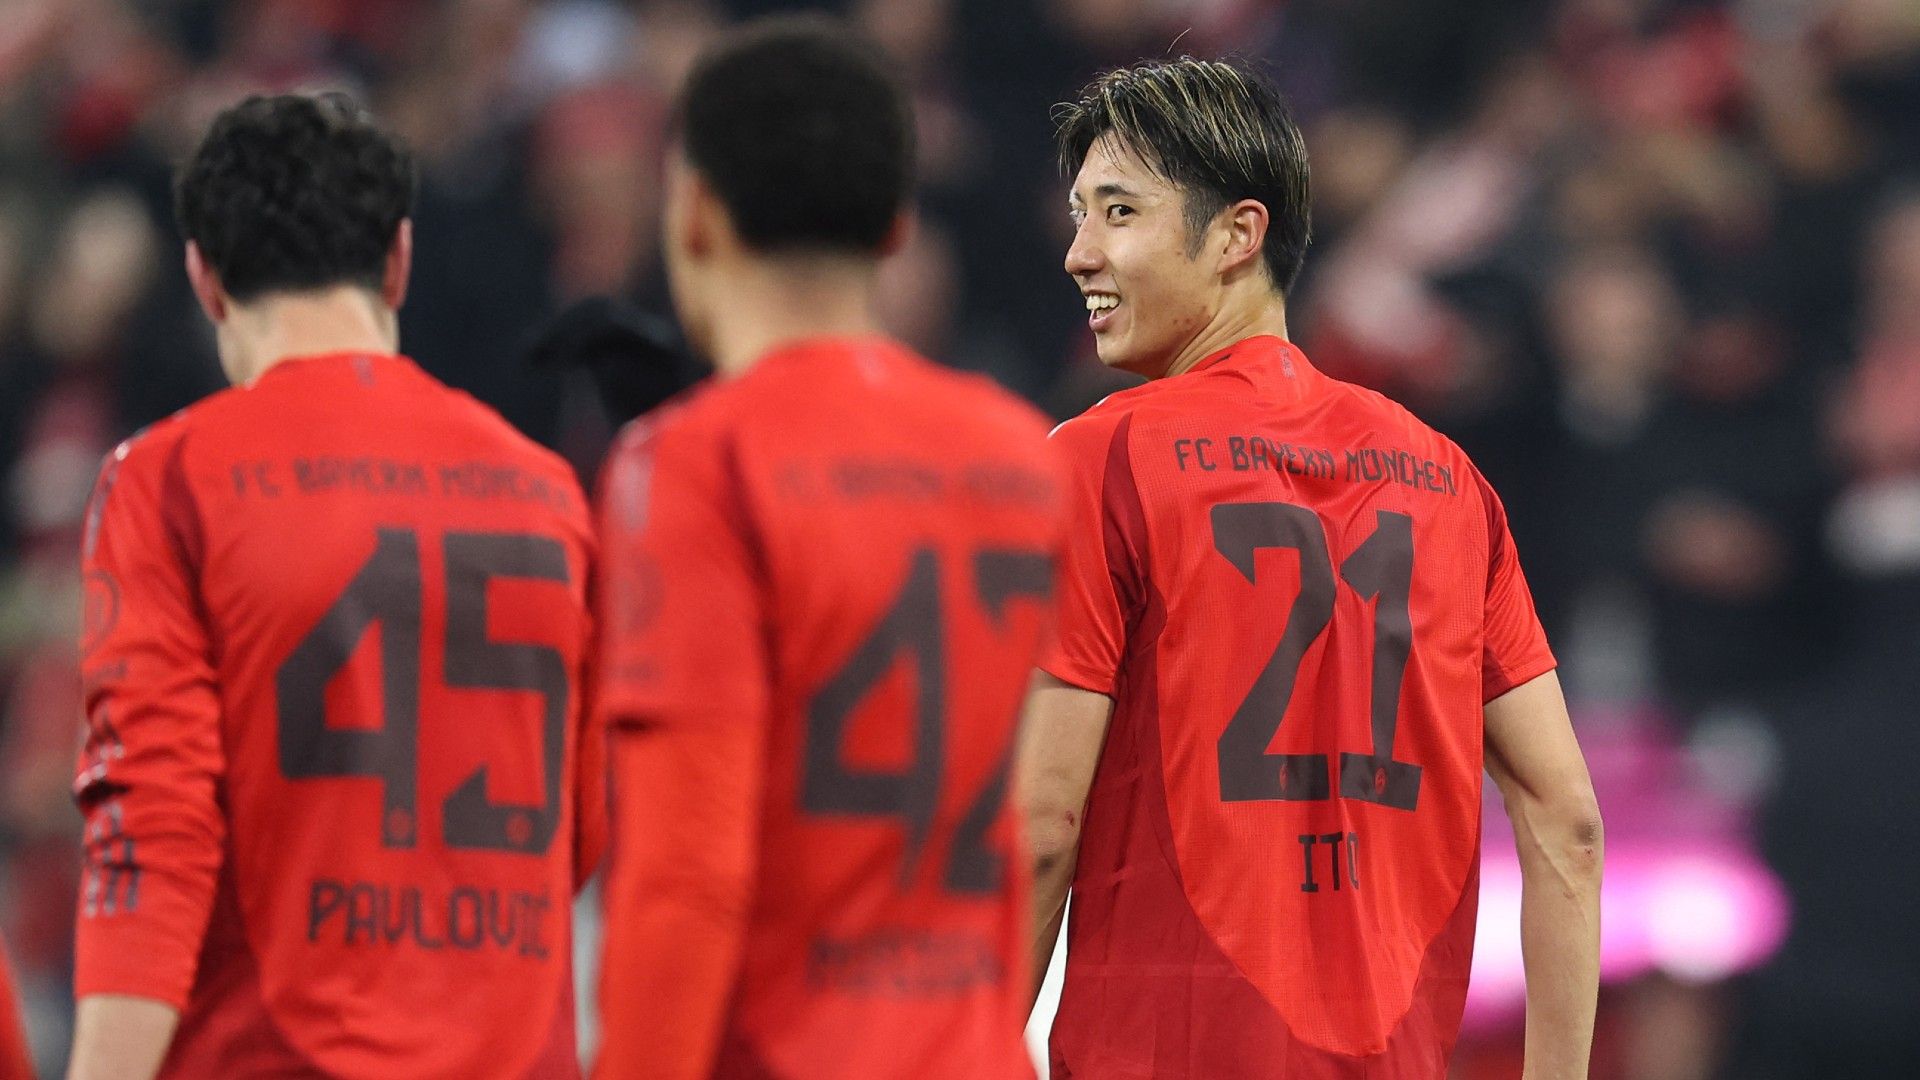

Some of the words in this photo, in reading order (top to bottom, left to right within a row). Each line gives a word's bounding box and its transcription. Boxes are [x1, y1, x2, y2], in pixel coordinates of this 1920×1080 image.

[1174, 438, 1217, 472] FC
[1228, 436, 1336, 481] BAYERN
[1345, 448, 1457, 497] MÜNCHEN
[276, 528, 570, 856] 45
[800, 545, 1055, 893] 42
[1211, 501, 1422, 812] 21
[1298, 831, 1359, 893] ITO
